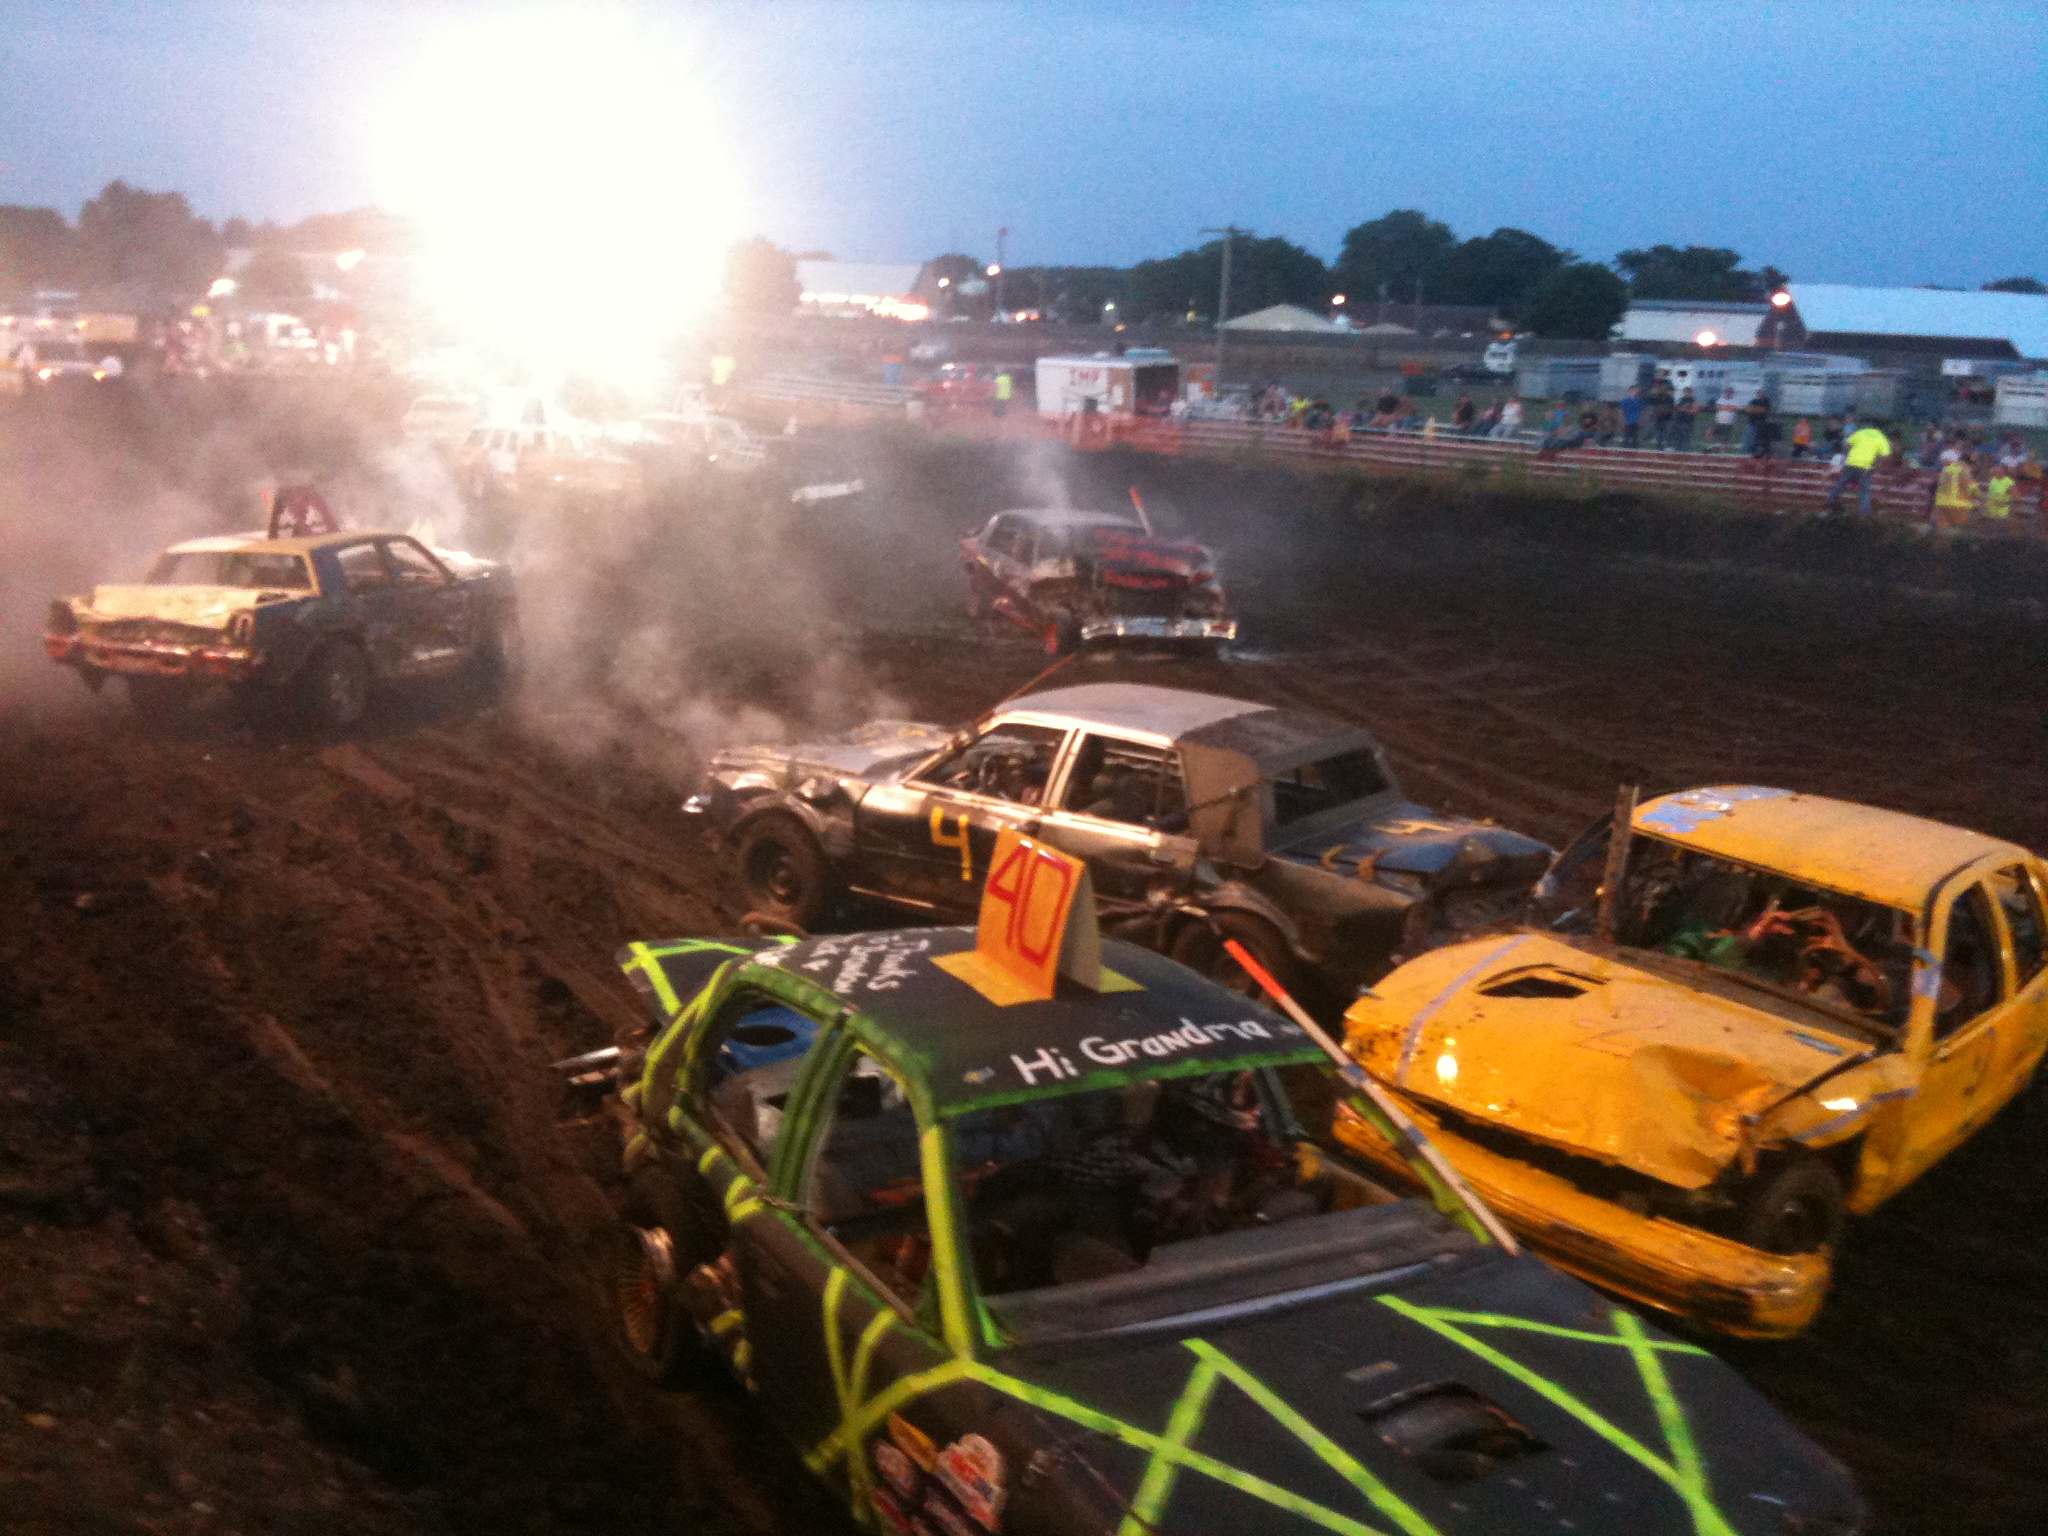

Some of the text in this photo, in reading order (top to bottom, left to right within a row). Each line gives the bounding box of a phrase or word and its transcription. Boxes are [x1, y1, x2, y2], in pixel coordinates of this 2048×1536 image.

[930, 807, 972, 881] 4
[987, 839, 1073, 969] 40
[1010, 1017, 1272, 1086] Hi Grandma
